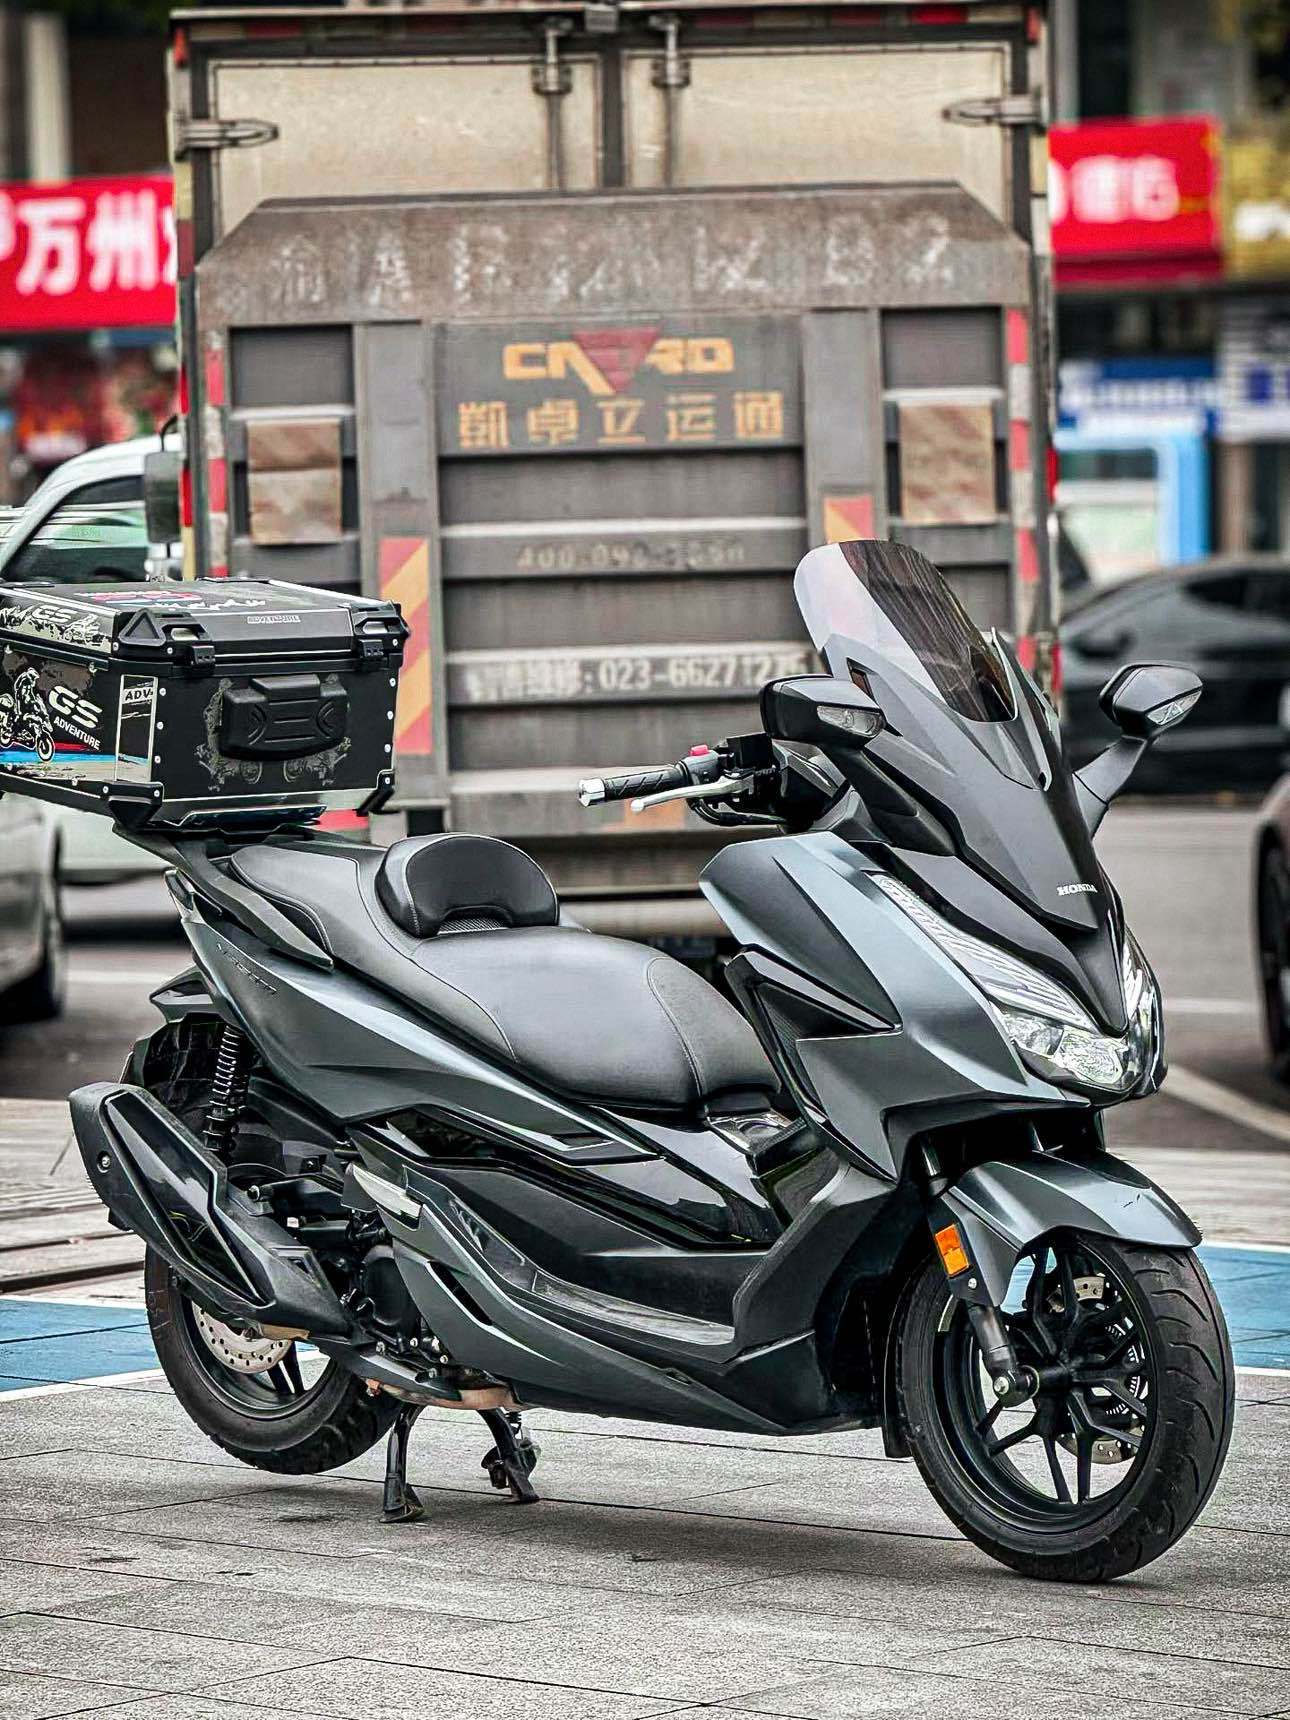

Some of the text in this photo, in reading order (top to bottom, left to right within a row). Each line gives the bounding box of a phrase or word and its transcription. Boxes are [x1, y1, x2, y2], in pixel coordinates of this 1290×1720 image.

[0, 188, 178, 297] 万州
[32, 604, 78, 624] GS
[49, 685, 103, 729] GS
[53, 715, 101, 750] ADVENTURE
[1056, 883, 1098, 896] HONDA
